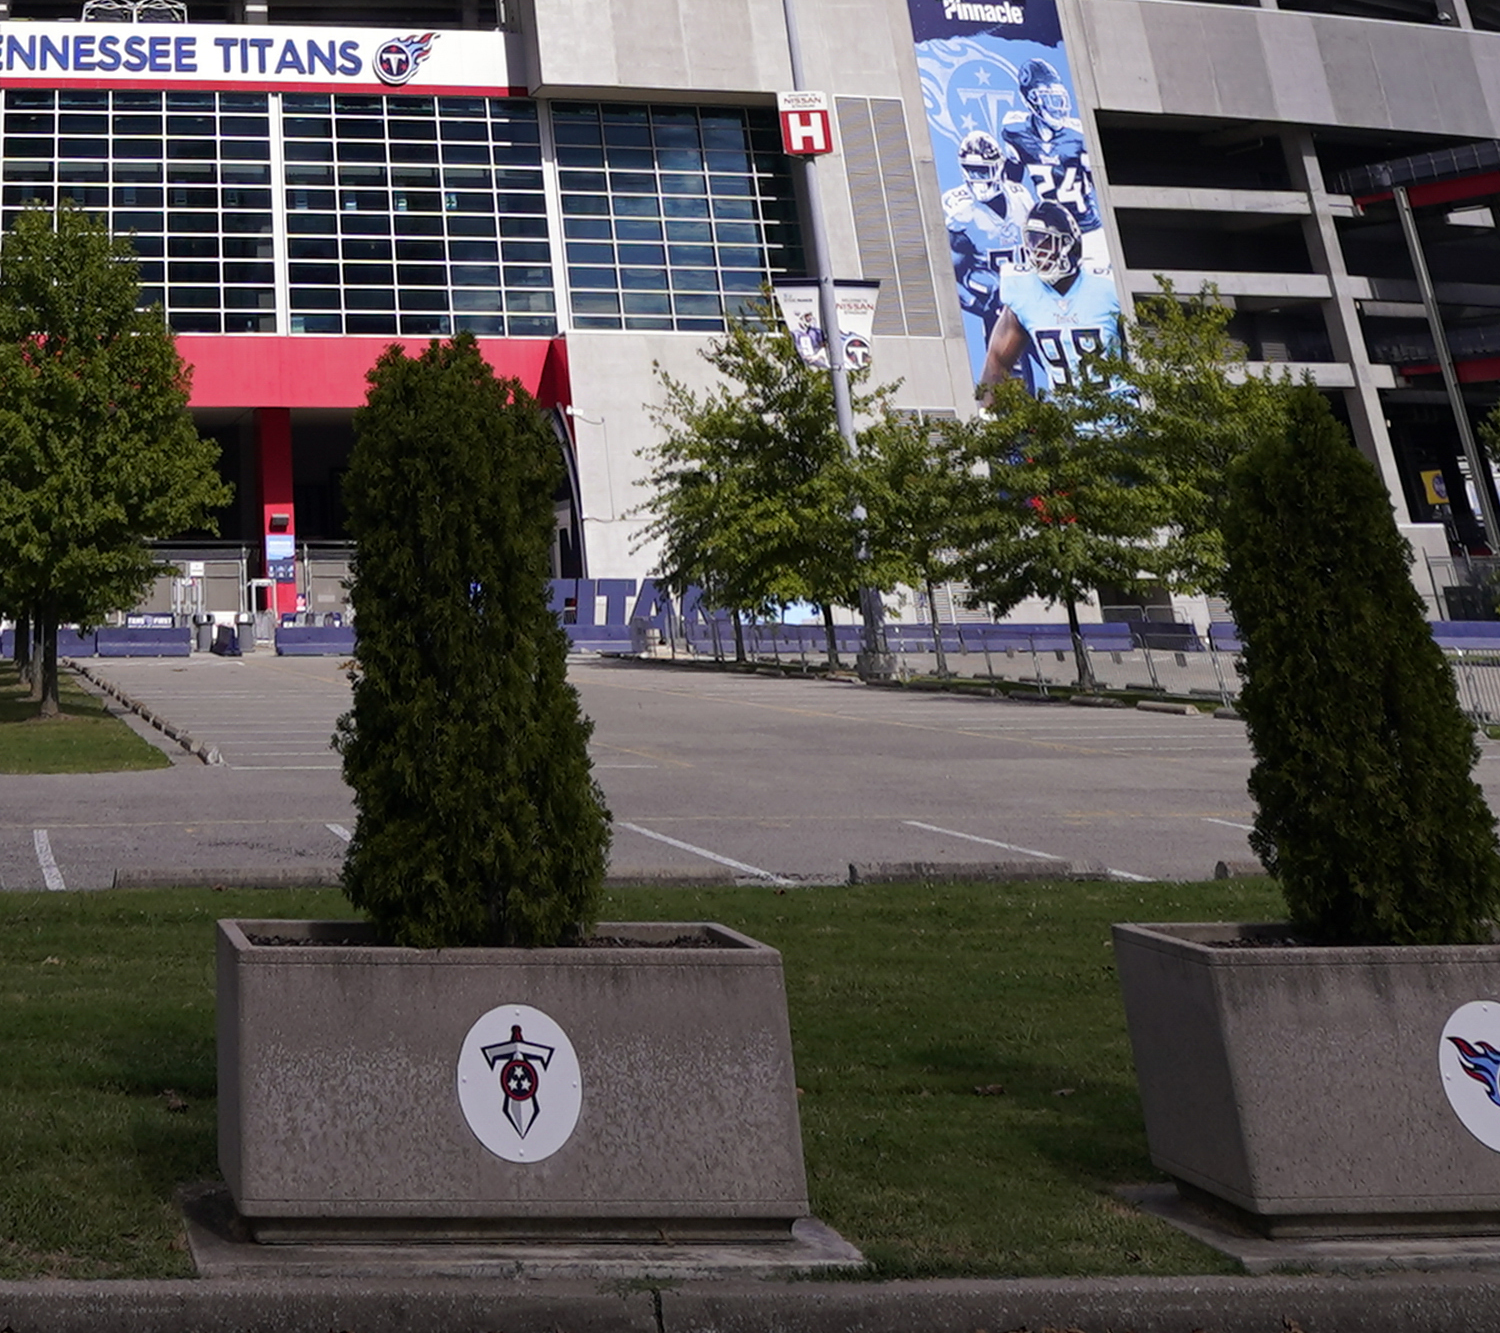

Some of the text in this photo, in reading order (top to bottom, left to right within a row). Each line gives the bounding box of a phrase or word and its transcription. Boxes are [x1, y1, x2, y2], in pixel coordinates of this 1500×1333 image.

[214, 38, 363, 75] TITANS
[783, 97, 822, 105] NISSAN
[788, 113, 826, 150] H
